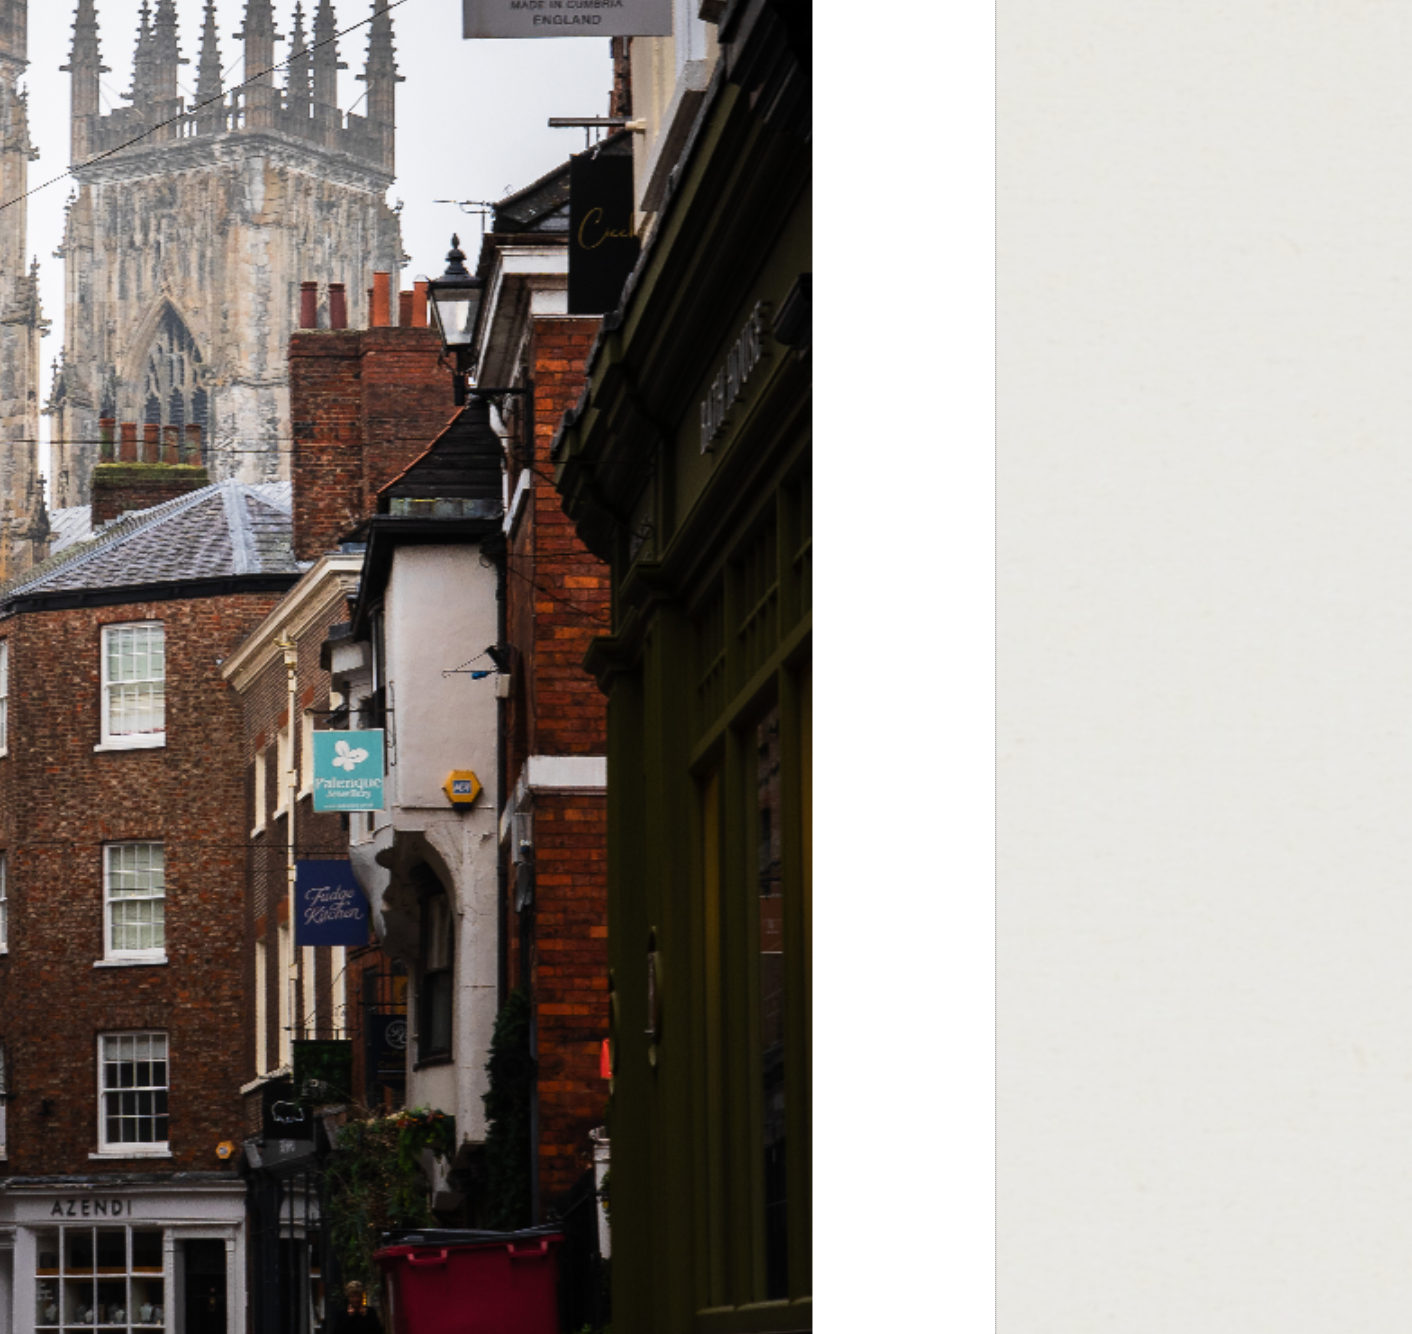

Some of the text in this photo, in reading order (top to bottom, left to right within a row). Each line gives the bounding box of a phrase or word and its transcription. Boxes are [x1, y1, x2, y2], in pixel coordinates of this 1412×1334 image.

[510, 0, 545, 10] MADE
[549, 0, 562, 9] IN
[532, 14, 602, 25] ENGLAND
[304, 884, 356, 907] Fudge
[303, 901, 365, 925] Kitchen
[50, 1199, 133, 1217] AZENDI
